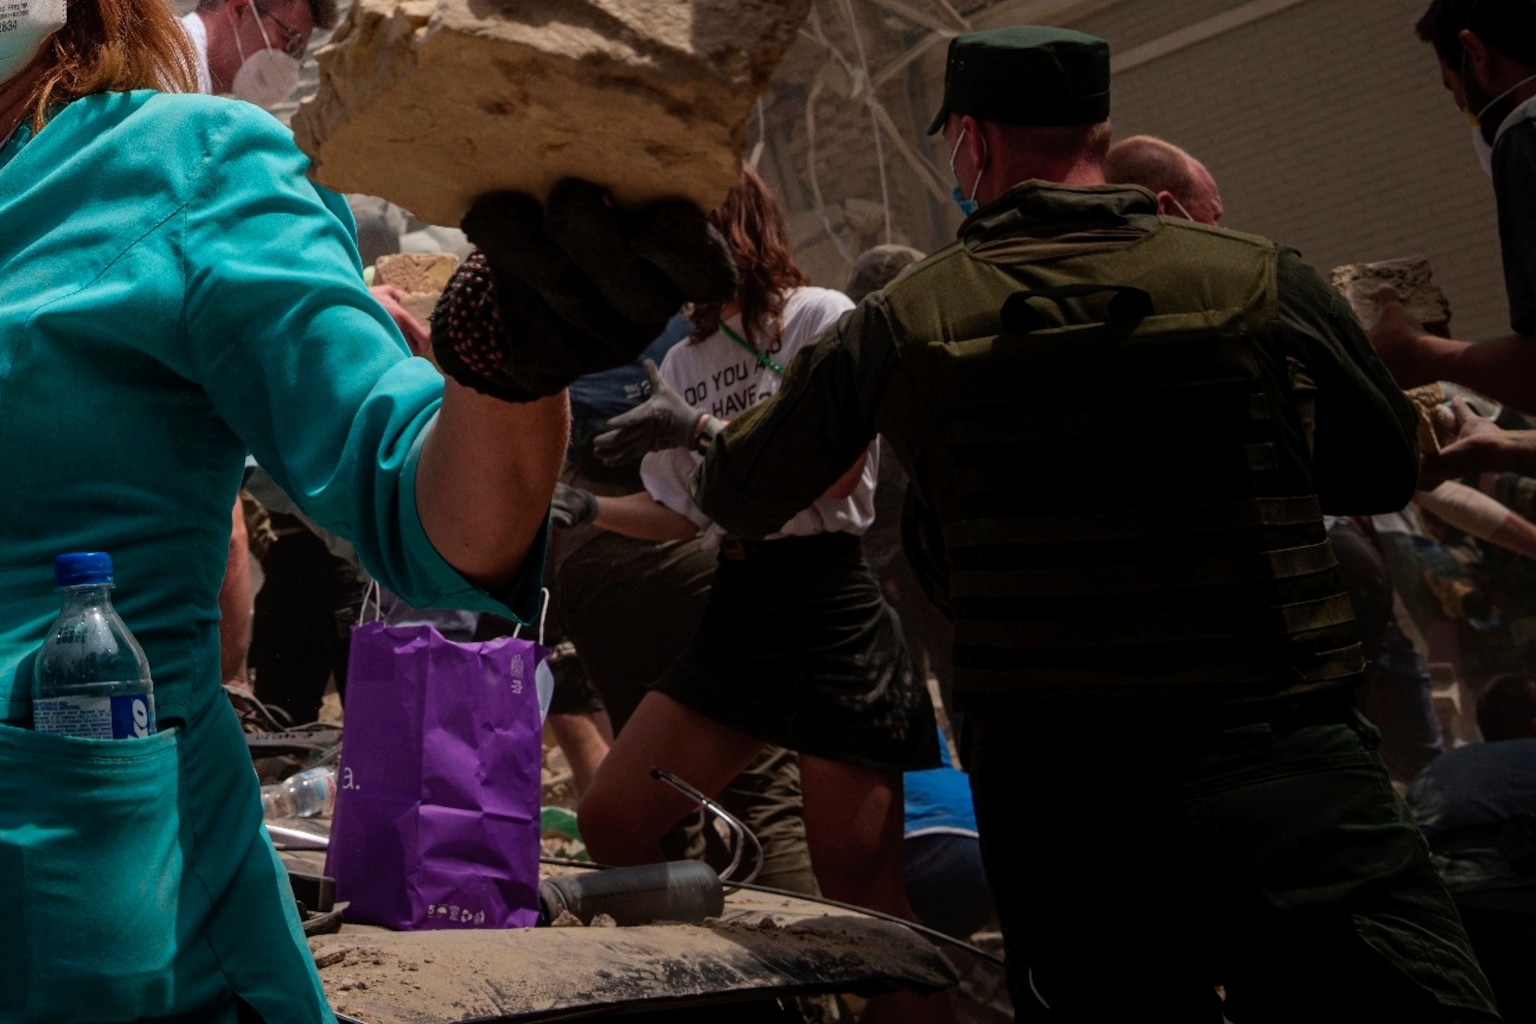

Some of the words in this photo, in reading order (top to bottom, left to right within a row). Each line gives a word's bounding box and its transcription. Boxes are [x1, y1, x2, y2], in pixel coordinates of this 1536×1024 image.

[684, 380, 708, 406] DO
[711, 359, 749, 392] YOU
[711, 383, 758, 419] HAVE
